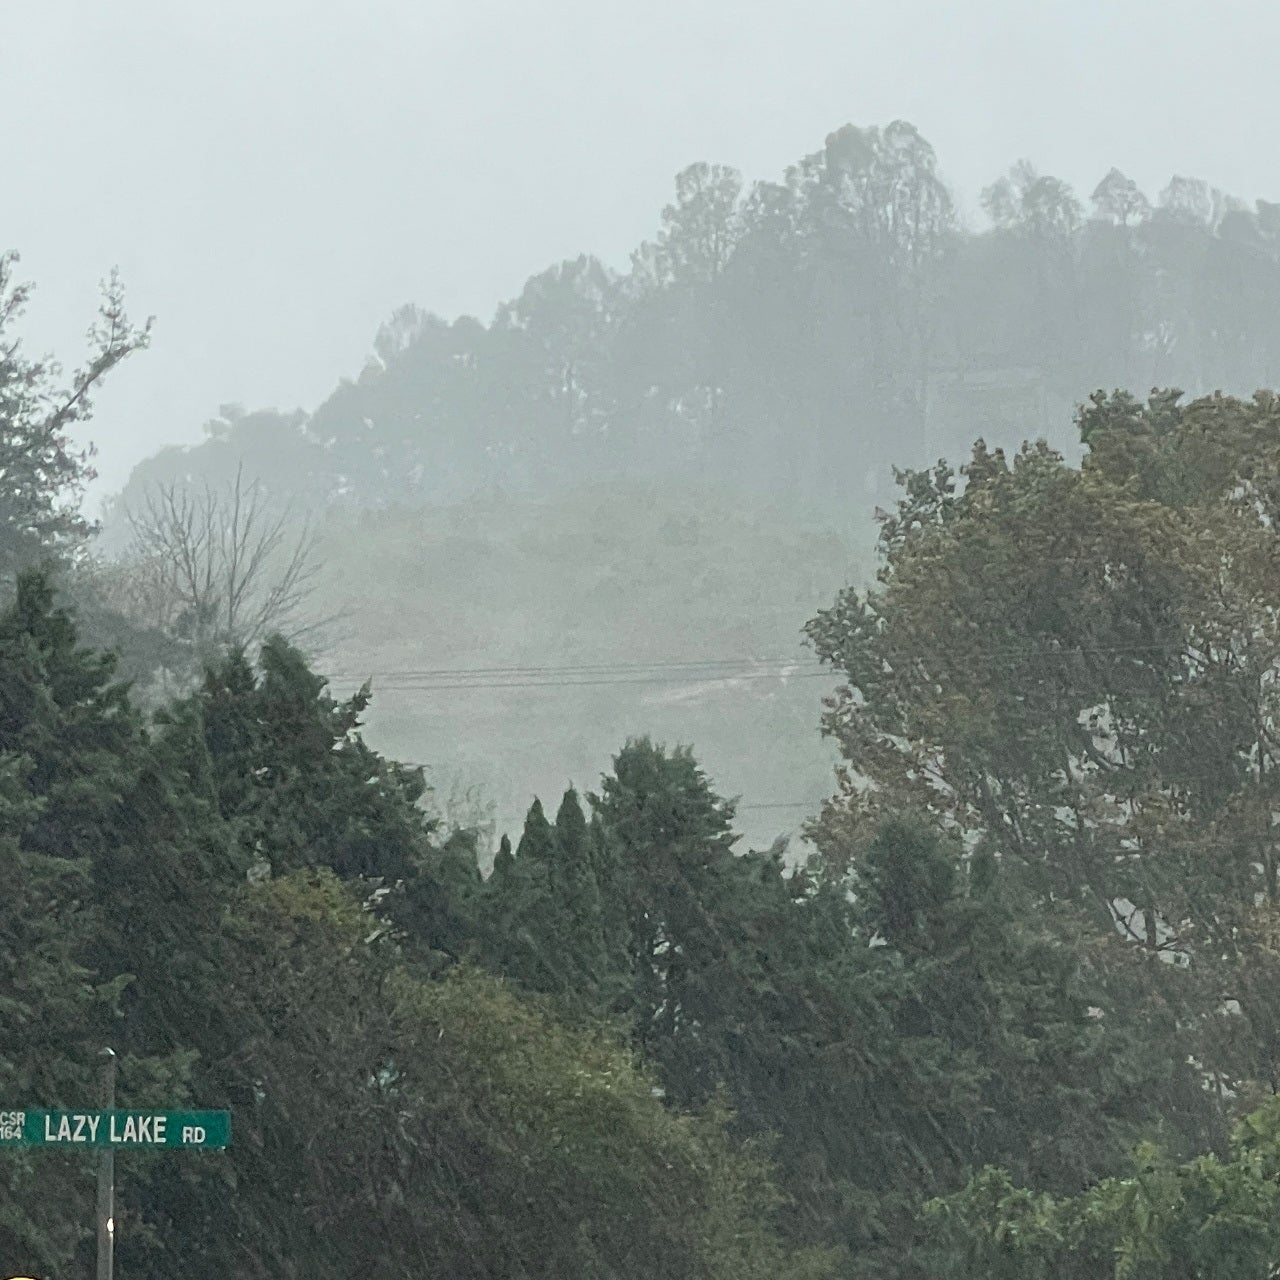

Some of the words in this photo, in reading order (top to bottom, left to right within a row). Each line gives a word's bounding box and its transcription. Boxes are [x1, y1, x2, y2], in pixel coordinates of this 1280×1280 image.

[44, 1114, 101, 1142] LAZY
[110, 1115, 167, 1143] LAKE
[182, 1126, 206, 1144] RD
